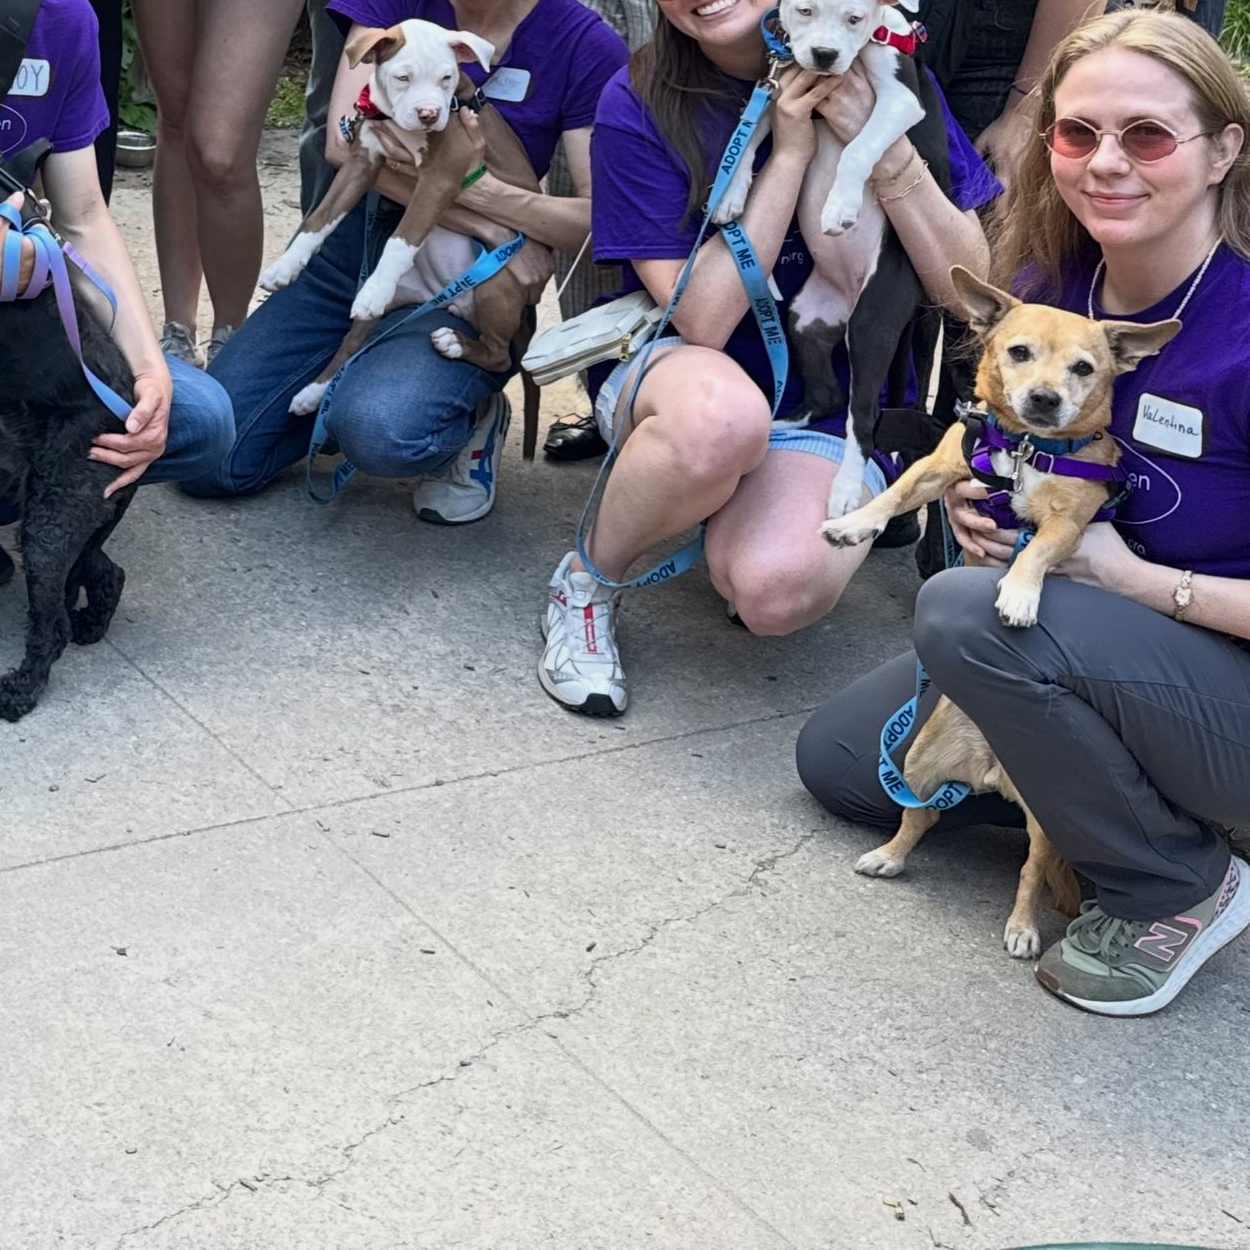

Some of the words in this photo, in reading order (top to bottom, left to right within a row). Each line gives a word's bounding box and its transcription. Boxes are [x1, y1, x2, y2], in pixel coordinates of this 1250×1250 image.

[721, 130, 748, 174] ADOPT
[735, 248, 756, 270] ME
[883, 705, 914, 751] ADOPT
[881, 770, 905, 794] ME
